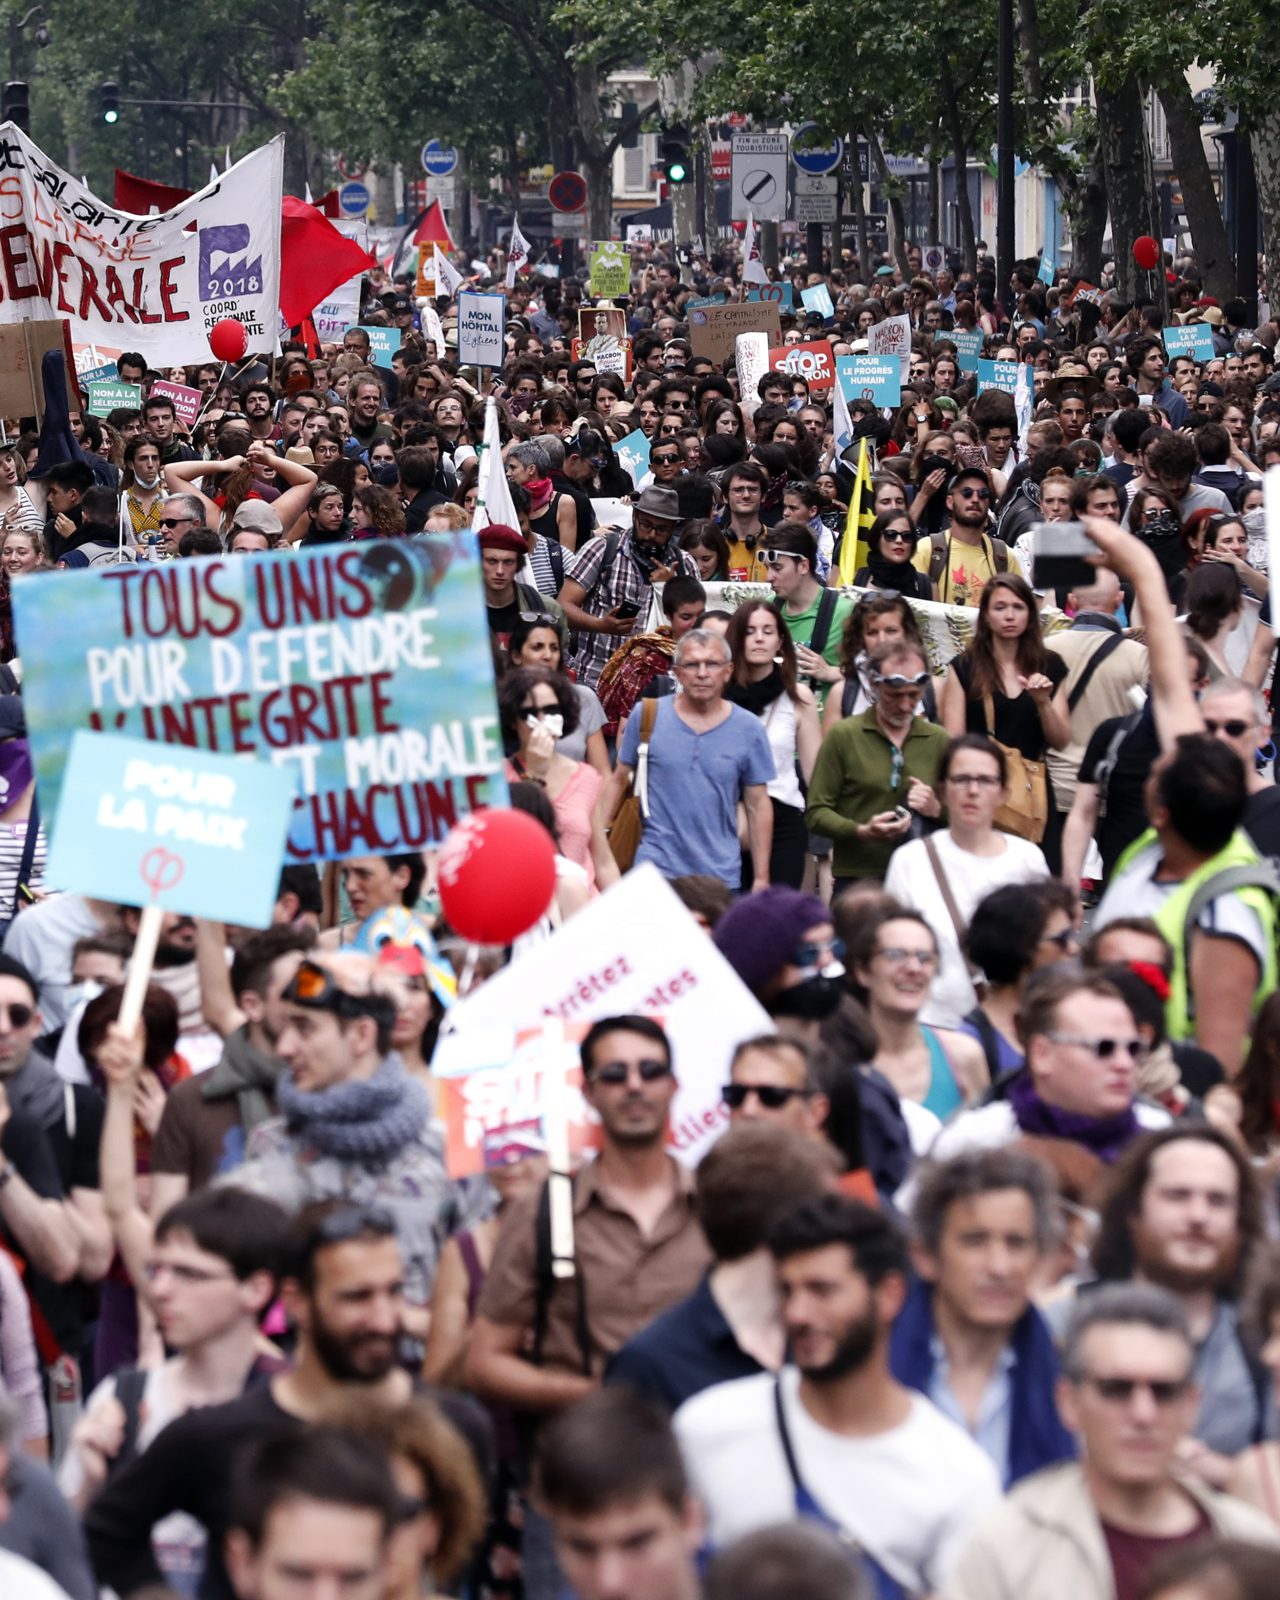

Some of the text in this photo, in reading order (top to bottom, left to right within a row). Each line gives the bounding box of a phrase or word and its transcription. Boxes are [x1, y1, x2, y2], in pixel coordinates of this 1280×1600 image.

[208, 276, 259, 299] 2018
[468, 311, 492, 321] MON
[461, 319, 500, 333] HÔPITAL
[1178, 326, 1198, 335] POUR
[939, 332, 980, 342] POUR SORTIR
[1167, 338, 1212, 349] RÉPUBLIQUE
[597, 351, 622, 361] MACRON
[775, 353, 828, 375] STOP
[856, 358, 880, 366] POUR
[843, 366, 893, 375] LE PROGRÈS
[994, 364, 1018, 374] POUR
[850, 376, 886, 385] HUMAIN
[995, 373, 1006, 382] LA
[93, 388, 136, 398] NON À LA
[154, 388, 197, 405] NON À LA
[93, 398, 137, 408] SÉLECTION
[103, 550, 375, 639] TOUS UNIS
[87, 639, 190, 708] POUR
[344, 715, 501, 789] MORALE
[123, 759, 237, 810] POUR
[96, 794, 248, 851] LA PAIX
